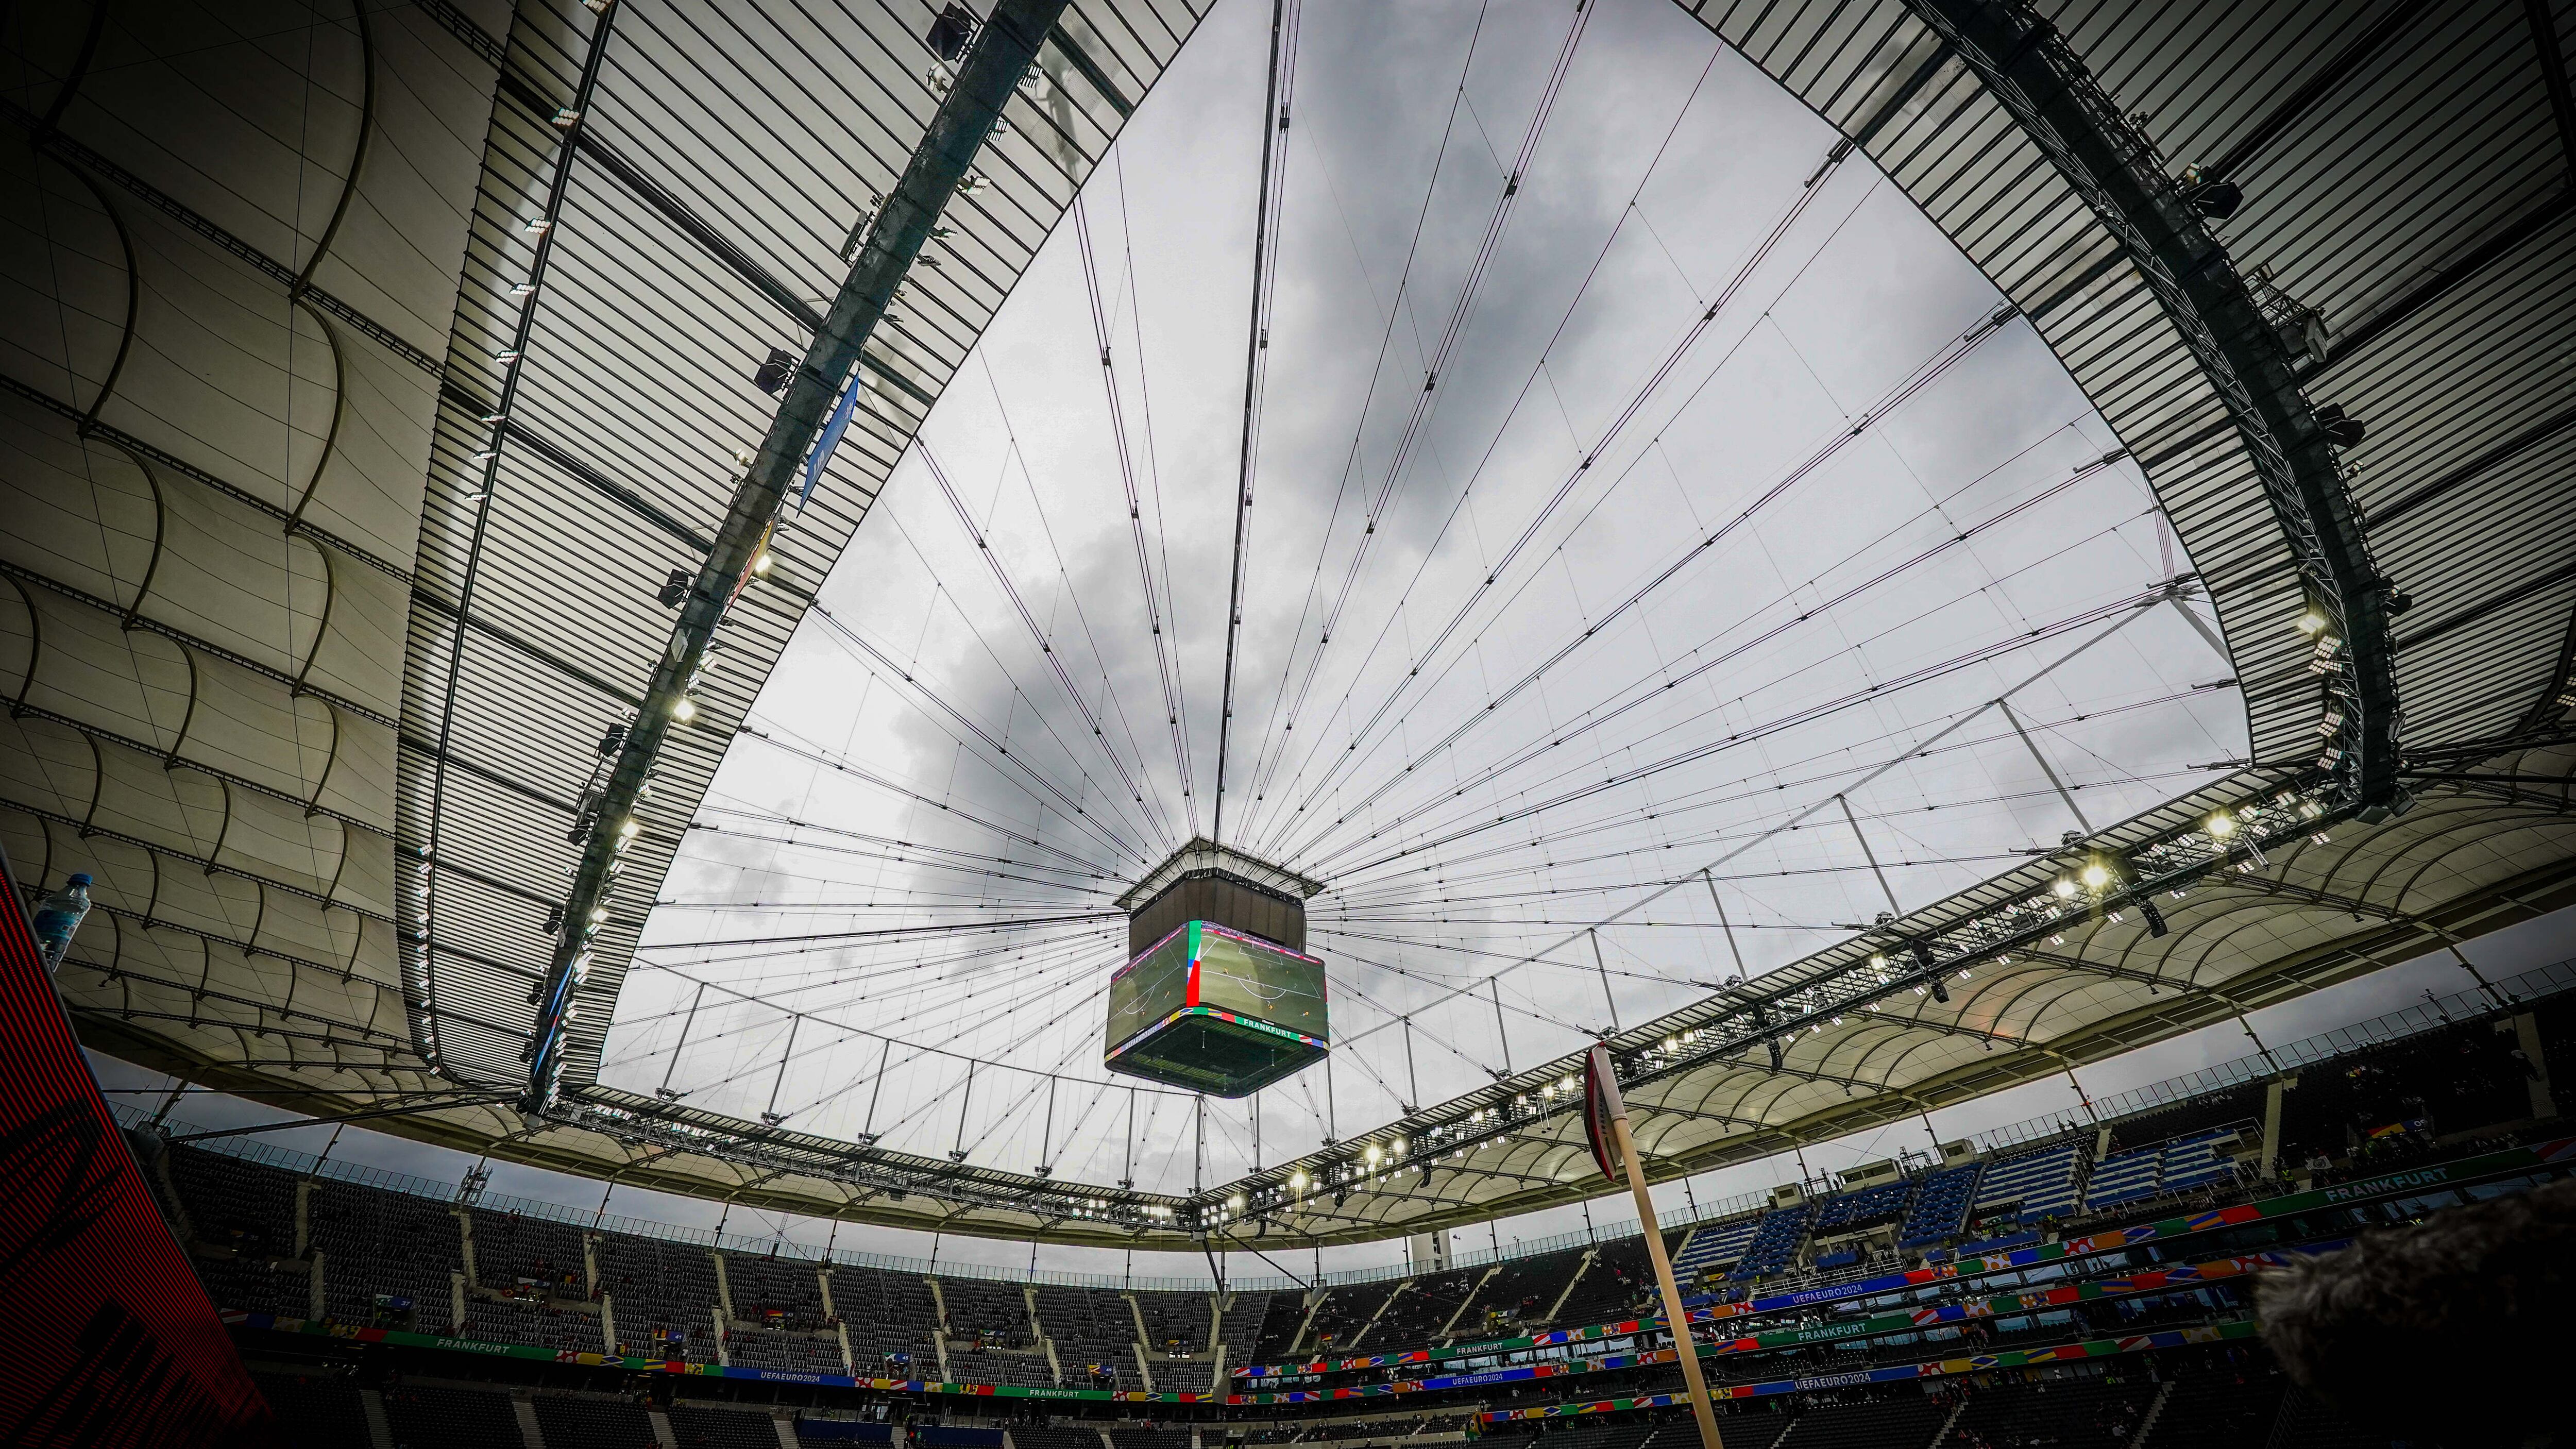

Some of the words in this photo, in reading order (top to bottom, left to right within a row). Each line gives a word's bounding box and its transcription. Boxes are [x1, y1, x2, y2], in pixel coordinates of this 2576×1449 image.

[1244, 1019, 1291, 1038] FRANKFURT
[2325, 1168, 2448, 1202] FRANKFURT
[1798, 1323, 1866, 1341] FRANKFURT
[437, 1339, 510, 1354] FRANKFURT
[1456, 1342, 1503, 1355] FRANKFURT
